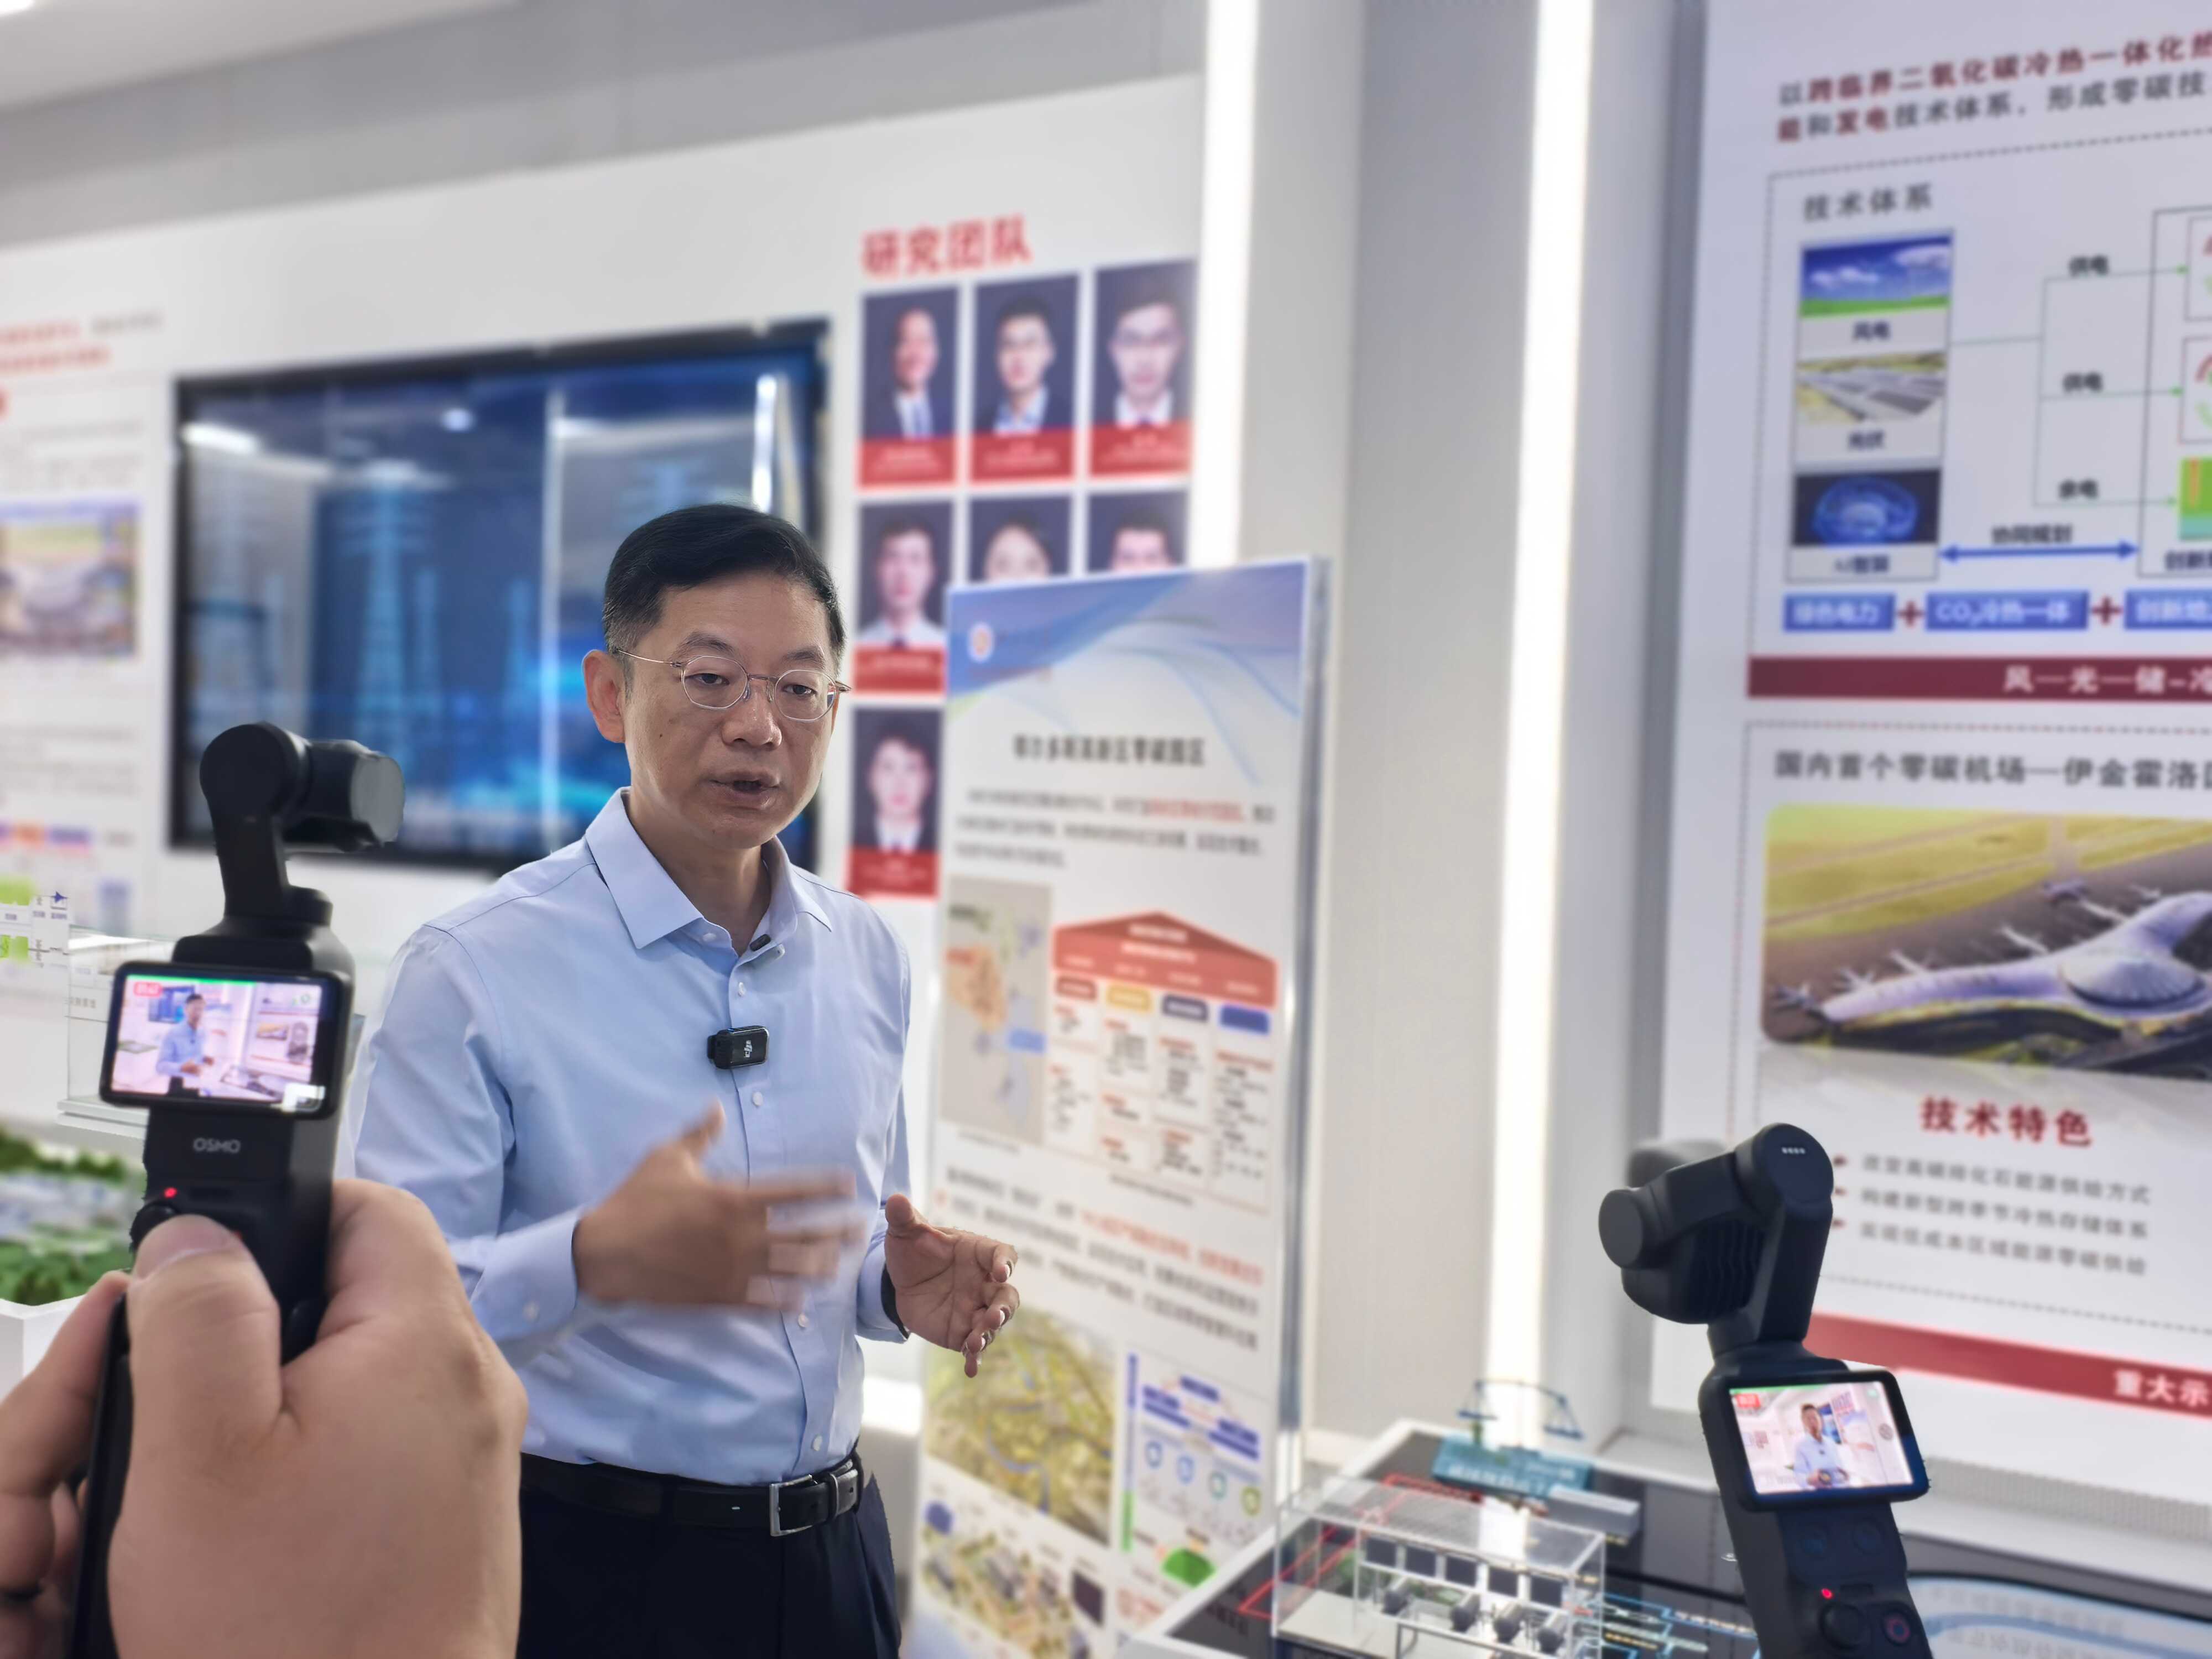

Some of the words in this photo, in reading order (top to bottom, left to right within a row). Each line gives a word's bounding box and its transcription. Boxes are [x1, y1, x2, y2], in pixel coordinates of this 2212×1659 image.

[1804, 184, 1933, 222] 技术体系
[863, 215, 1033, 274] 研究团队
[1775, 752, 2212, 790] 国内首个零碳机场—伊金霍洛
[1921, 1097, 2094, 1148] 技术特色
[194, 1138, 241, 1154] OSMO
[2115, 1370, 2209, 1407] 重大示
